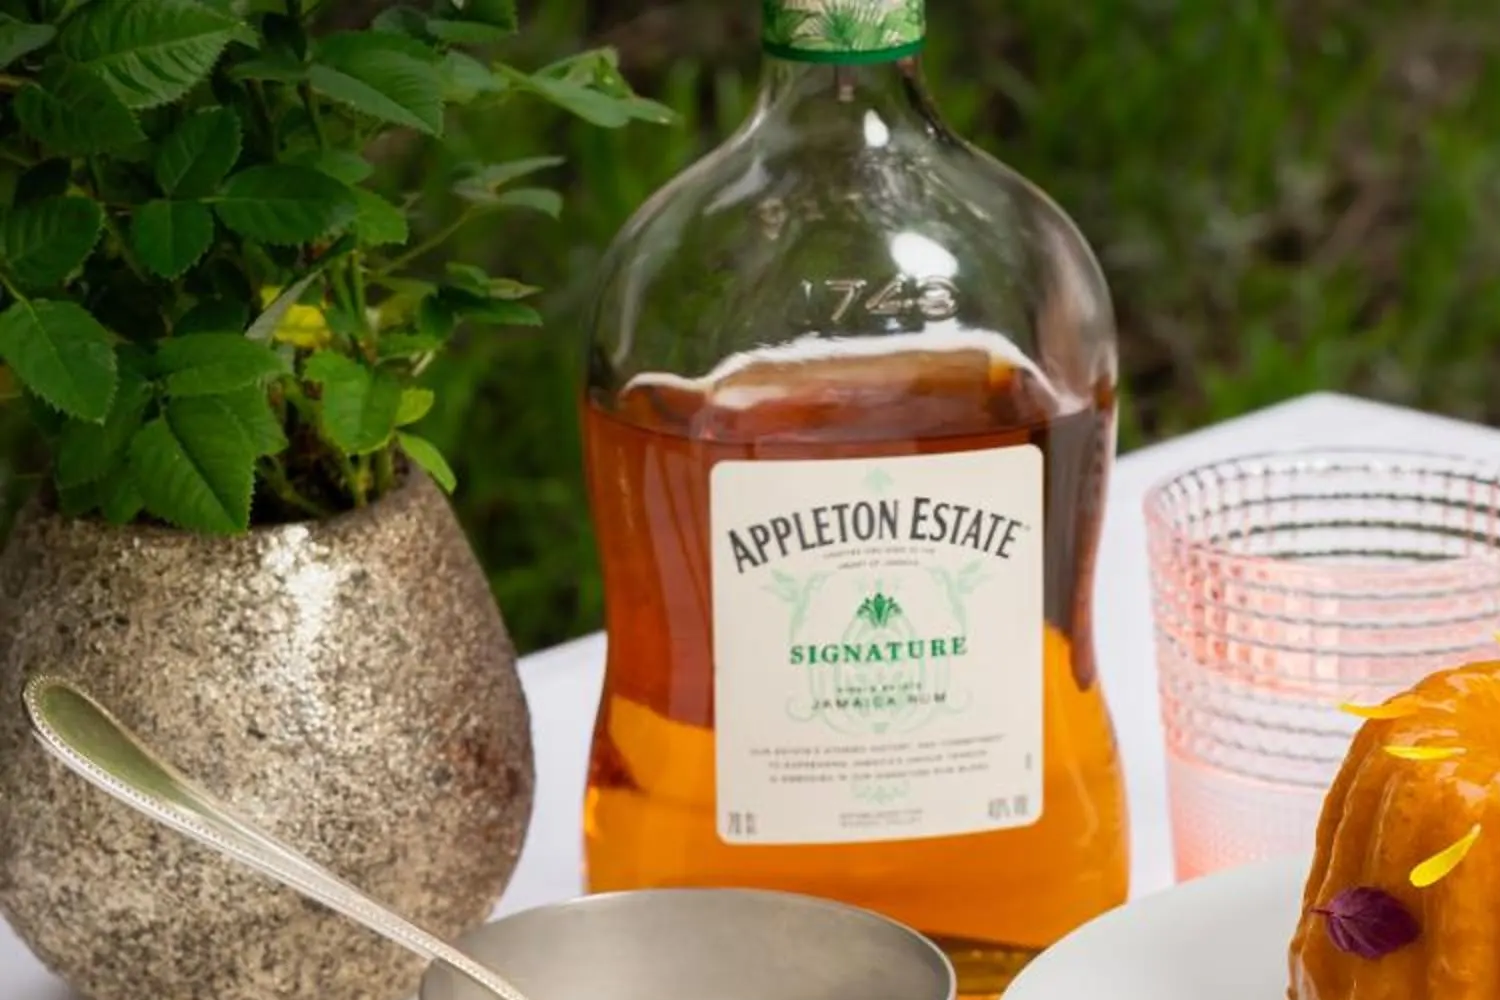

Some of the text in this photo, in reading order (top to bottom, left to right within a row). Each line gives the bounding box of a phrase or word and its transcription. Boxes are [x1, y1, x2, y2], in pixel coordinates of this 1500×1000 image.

[727, 497, 1022, 573] APPLETON ESTATE
[789, 636, 968, 666] SIGNATURE
[812, 695, 896, 709] JAMAICA
